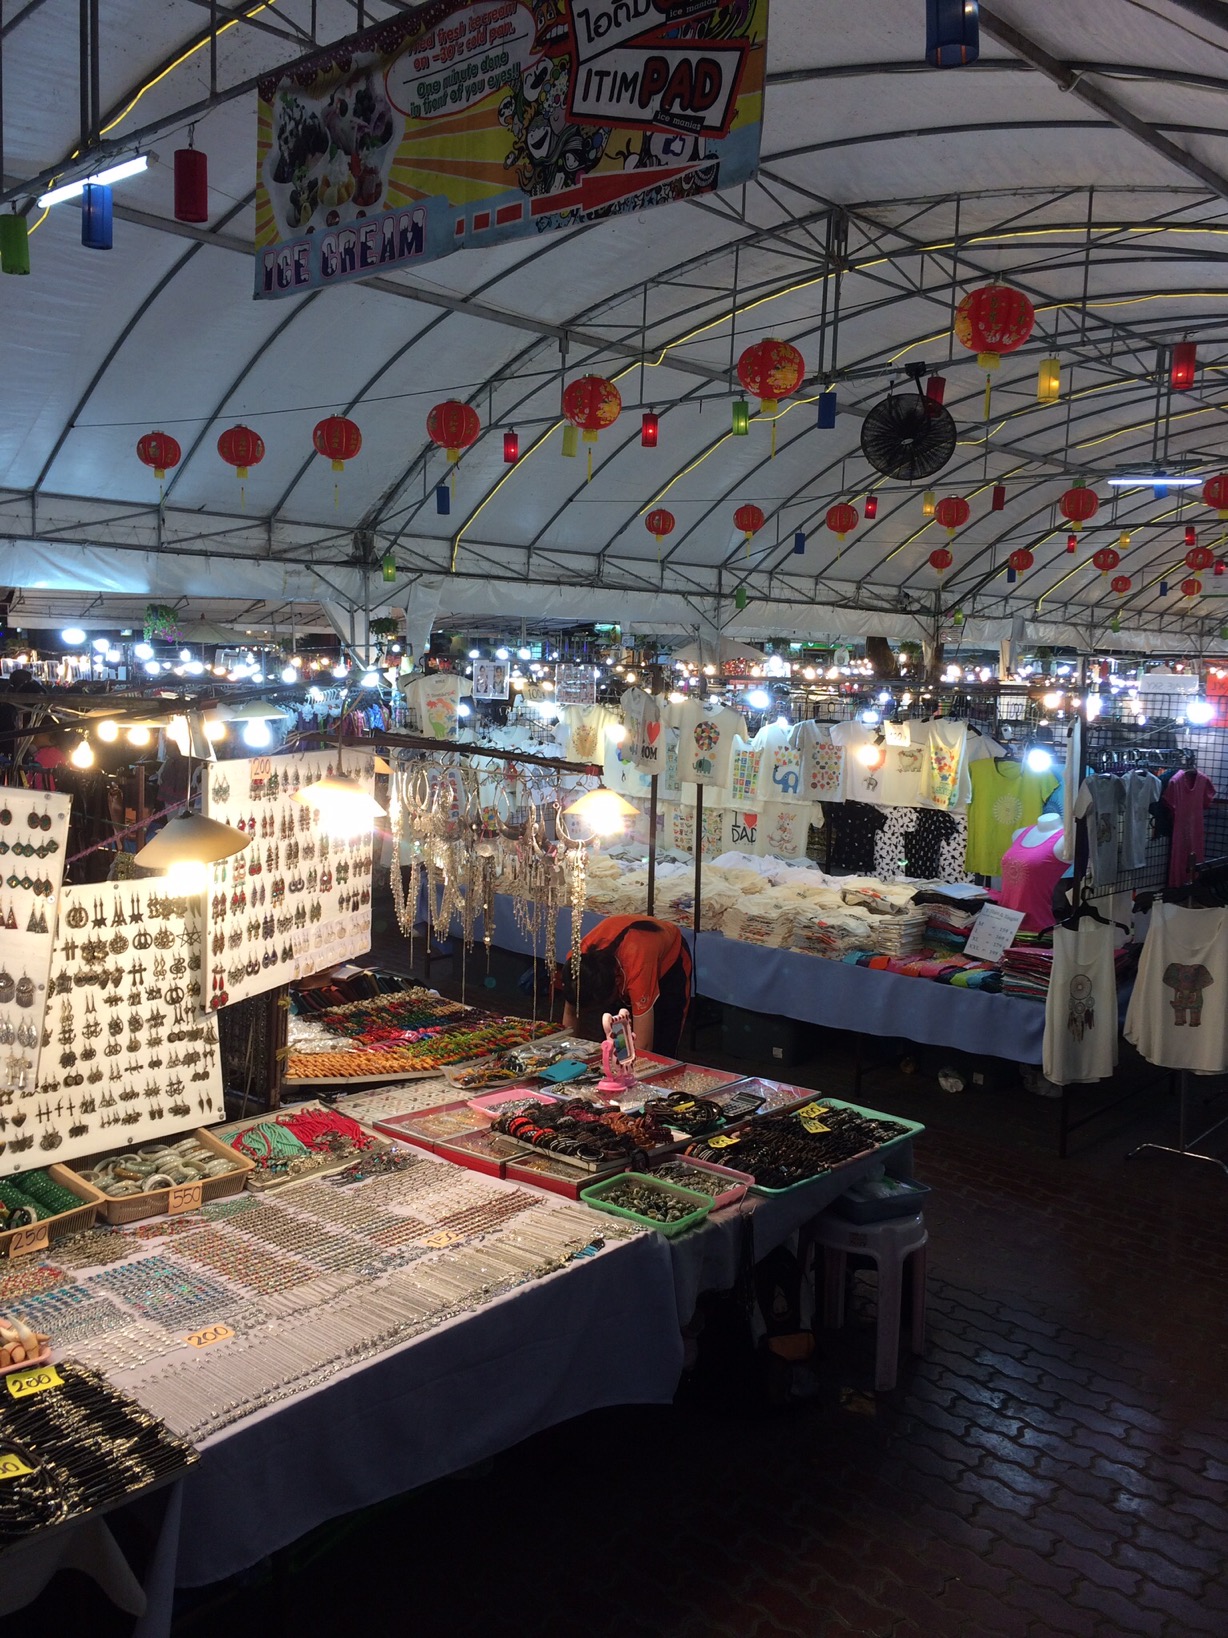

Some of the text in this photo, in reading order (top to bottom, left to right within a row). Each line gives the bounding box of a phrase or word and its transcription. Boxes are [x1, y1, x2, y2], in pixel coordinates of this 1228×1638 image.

[669, 8, 683, 18] ice
[437, 21, 467, 46] fresh
[413, 54, 430, 72] on
[466, 27, 488, 53] cold
[489, 21, 516, 45] pan.
[417, 51, 509, 99] One minute done
[410, 61, 521, 119] in front of you eyes!!
[657, 111, 671, 122] ice
[263, 206, 427, 291] ICE CREAM
[253, 757, 272, 776] 200
[731, 810, 741, 828] I
[731, 826, 757, 843] DAD
[172, 1185, 201, 1209] 550
[13, 1225, 47, 1251] 250
[187, 1326, 229, 1346] 200
[11, 1373, 52, 1393] 200
